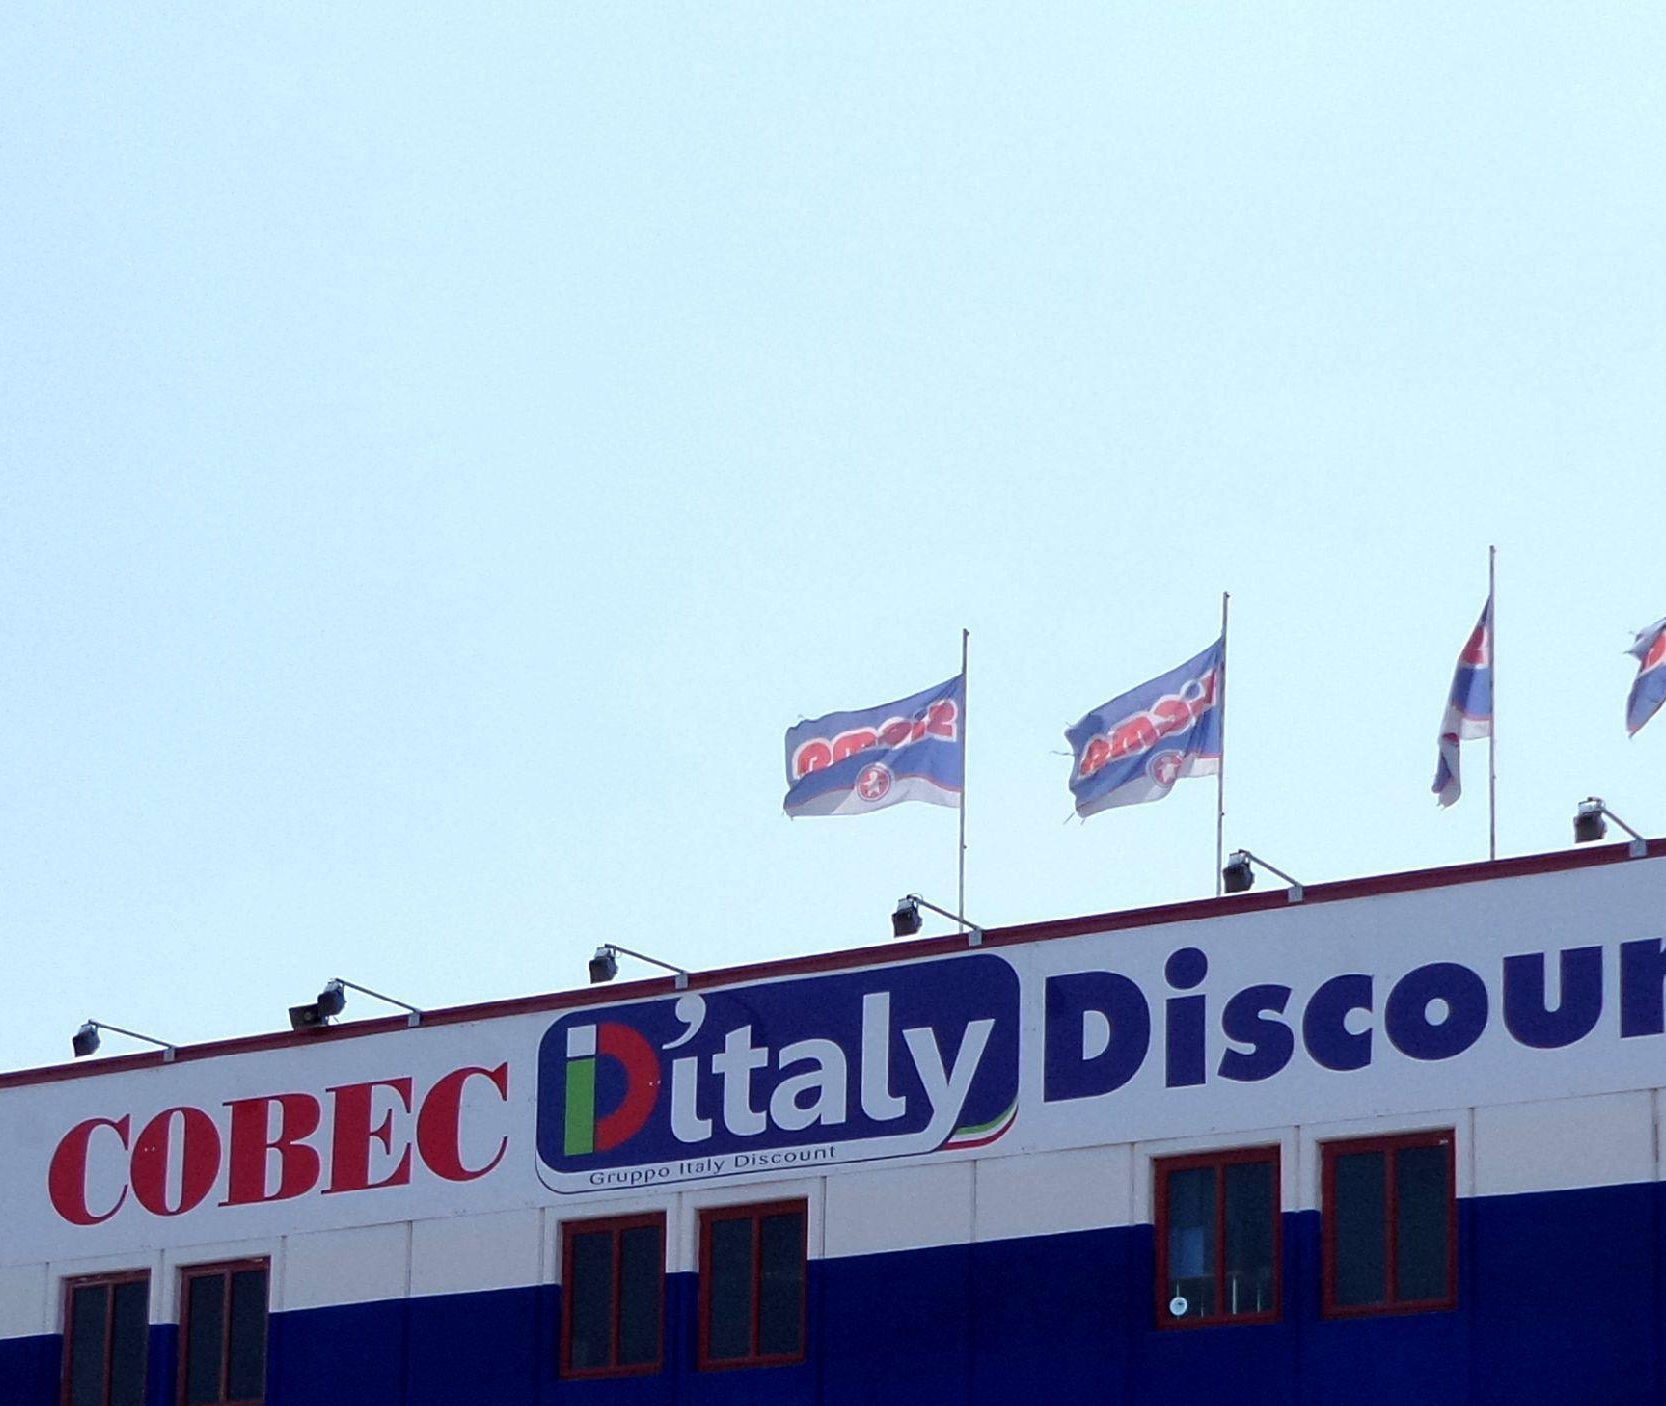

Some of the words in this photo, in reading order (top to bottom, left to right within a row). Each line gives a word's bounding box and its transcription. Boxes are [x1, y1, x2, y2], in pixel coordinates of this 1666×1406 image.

[49, 1062, 508, 1226] COBEC
[589, 1165, 670, 1185] Gruppo
[679, 1158, 725, 1175] Italy
[734, 1146, 838, 1168] Discount
